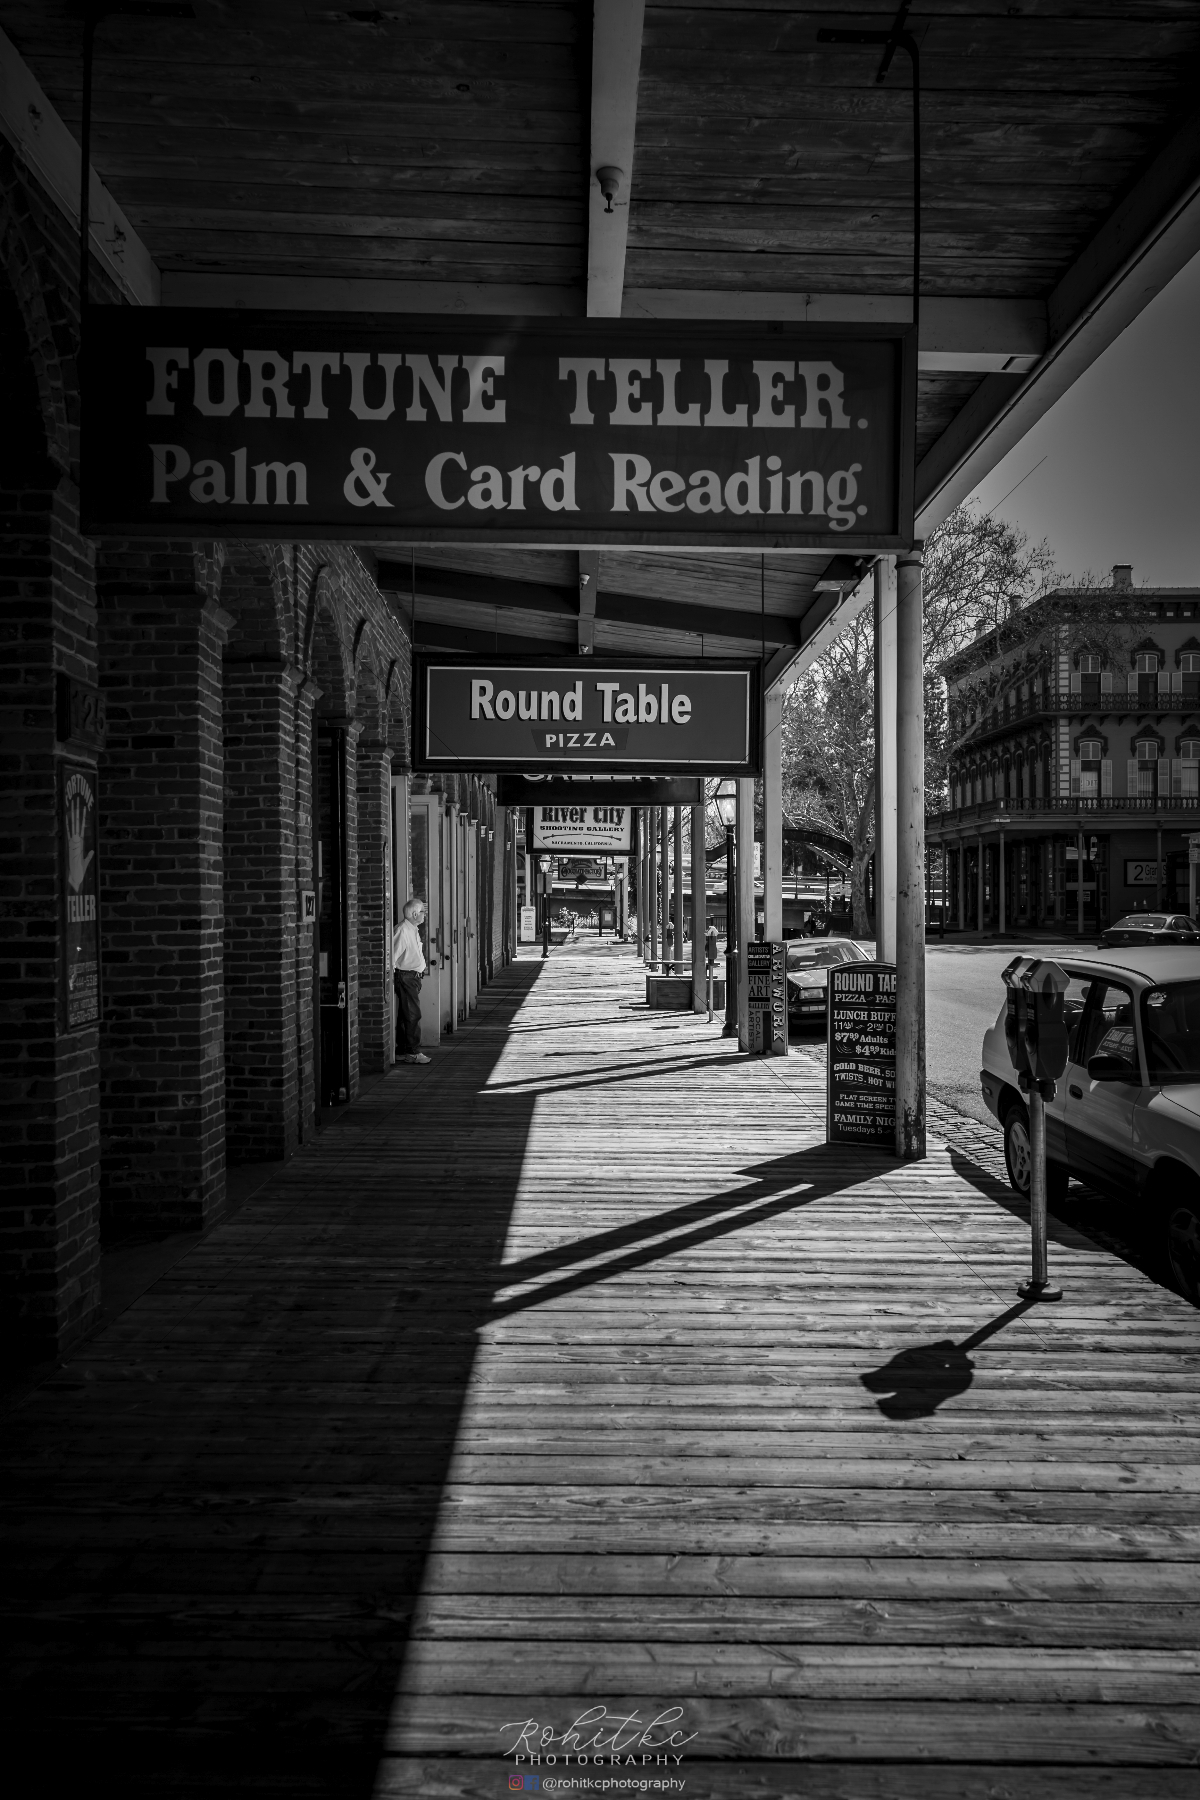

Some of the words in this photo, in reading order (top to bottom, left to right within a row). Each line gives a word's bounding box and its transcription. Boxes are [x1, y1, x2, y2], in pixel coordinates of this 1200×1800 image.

[145, 346, 506, 424] FORTUNE
[558, 356, 869, 430] TELLER.
[149, 443, 309, 506] Palm
[343, 446, 395, 508] &
[425, 450, 580, 513] Card
[608, 452, 868, 532] Reading.
[470, 679, 583, 721] Round
[596, 682, 692, 724] Table
[545, 732, 616, 748] PIZZA
[541, 807, 587, 823] River
[593, 806, 626, 826] City
[1133, 864, 1144, 881] 2
[67, 894, 96, 923] TELLER
[748, 959, 770, 967] GALLERY
[748, 975, 770, 985] FINE
[834, 972, 874, 991] ROUND
[748, 985, 771, 997] ART
[772, 943, 785, 1042] ARTWORK
[834, 993, 867, 1003] PIZZA
[748, 1002, 770, 1010] GALLERY
[833, 1010, 868, 1021] LUNCH
[859, 1034, 889, 1044] Adults
[833, 1062, 856, 1071] COLD
[868, 1076, 883, 1087] HOT
[839, 1093, 858, 1101] FLAT
[859, 1095, 887, 1103] SCREEN
[833, 1113, 874, 1125] FAMILY
[838, 1123, 876, 1135] Tuesdays
